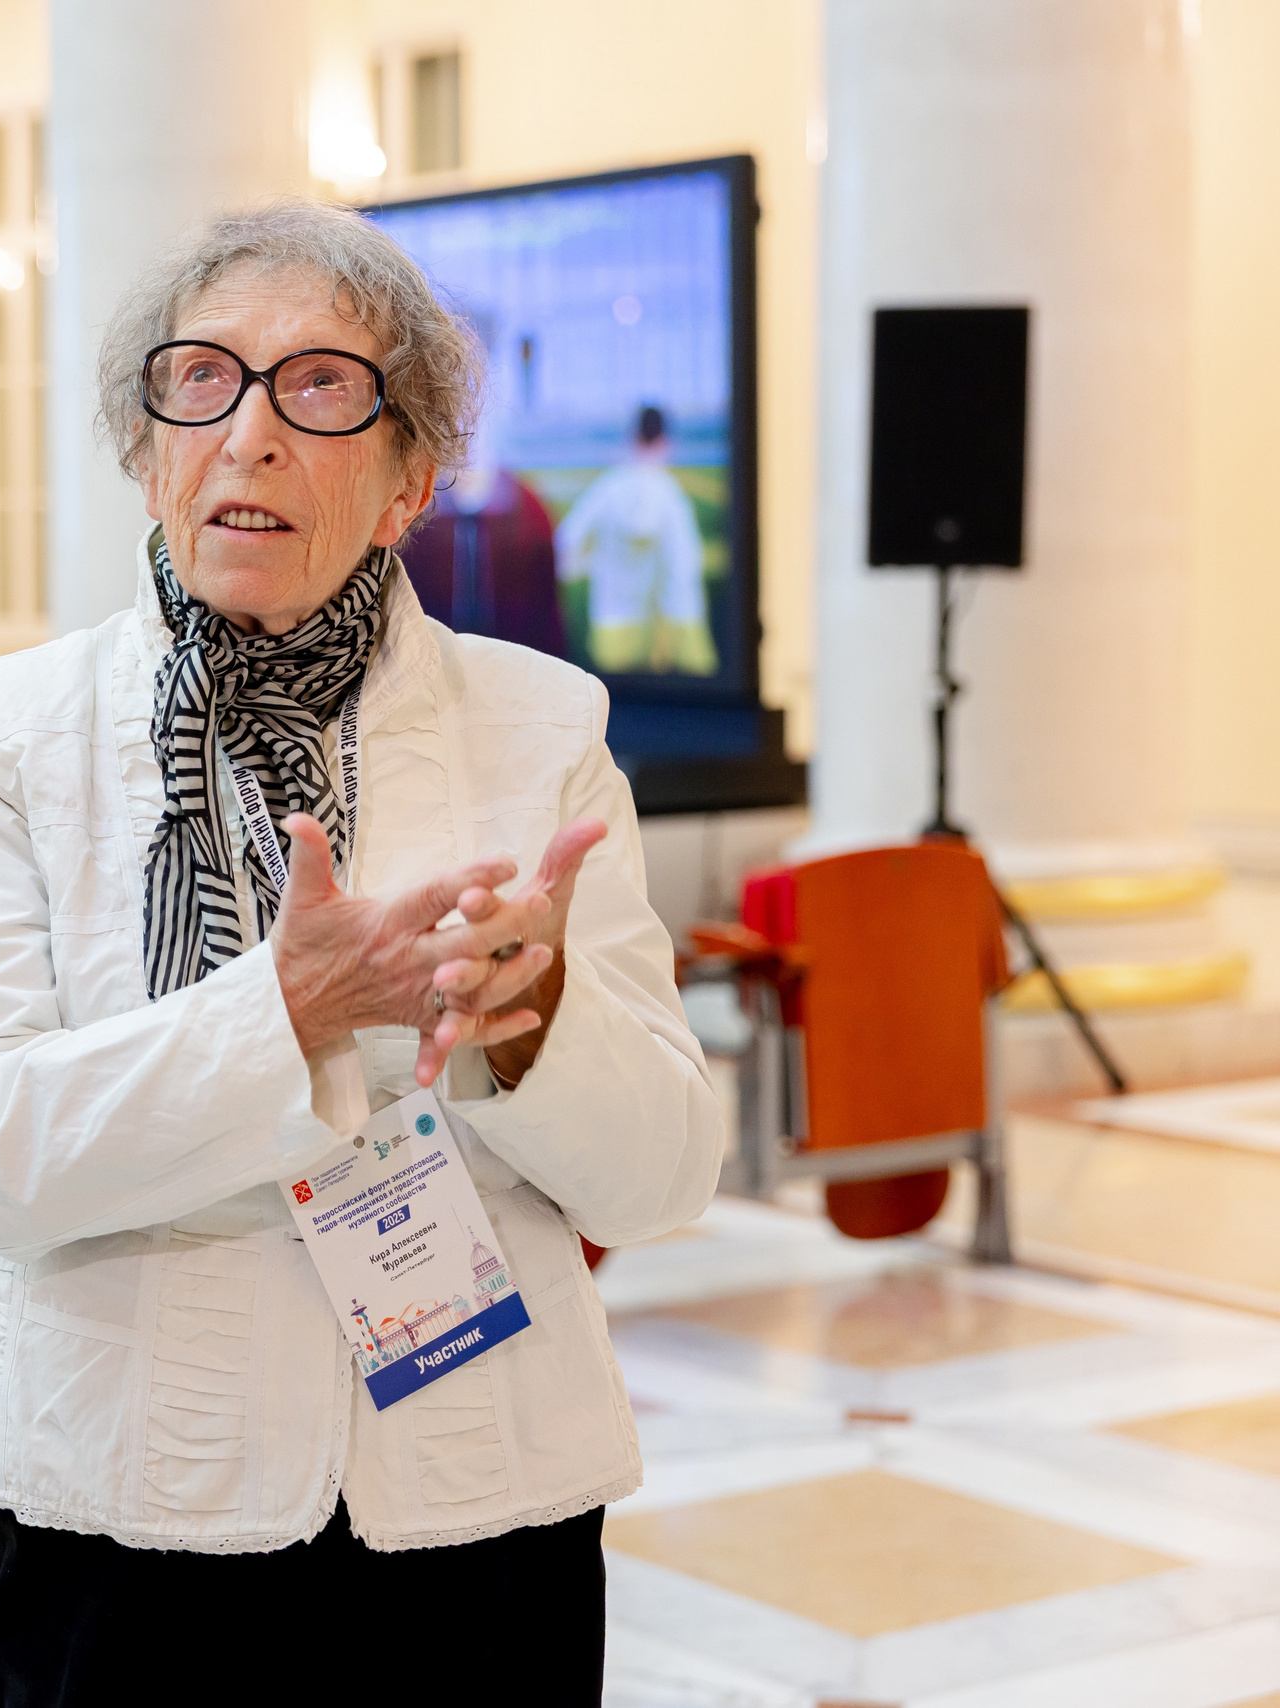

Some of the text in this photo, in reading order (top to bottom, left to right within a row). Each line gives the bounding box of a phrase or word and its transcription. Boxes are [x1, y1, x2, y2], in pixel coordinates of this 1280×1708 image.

[232, 768, 262, 816] ФОРУМ
[341, 751, 358, 804] ФОРУМ
[312, 1150, 444, 1225] Всероссийский форум экскурсоводов,
[316, 1192, 389, 1236] гидов-переводчиков
[394, 1157, 449, 1195] представителей
[347, 1182, 427, 1231] музейного сообщества
[368, 1220, 438, 1265] Кира Алексеевна
[382, 1209, 406, 1230] 2025
[381, 1242, 428, 1273] Муравьева
[390, 1252, 436, 1282] Санкт-Петербург
[414, 1326, 485, 1375] Участник
